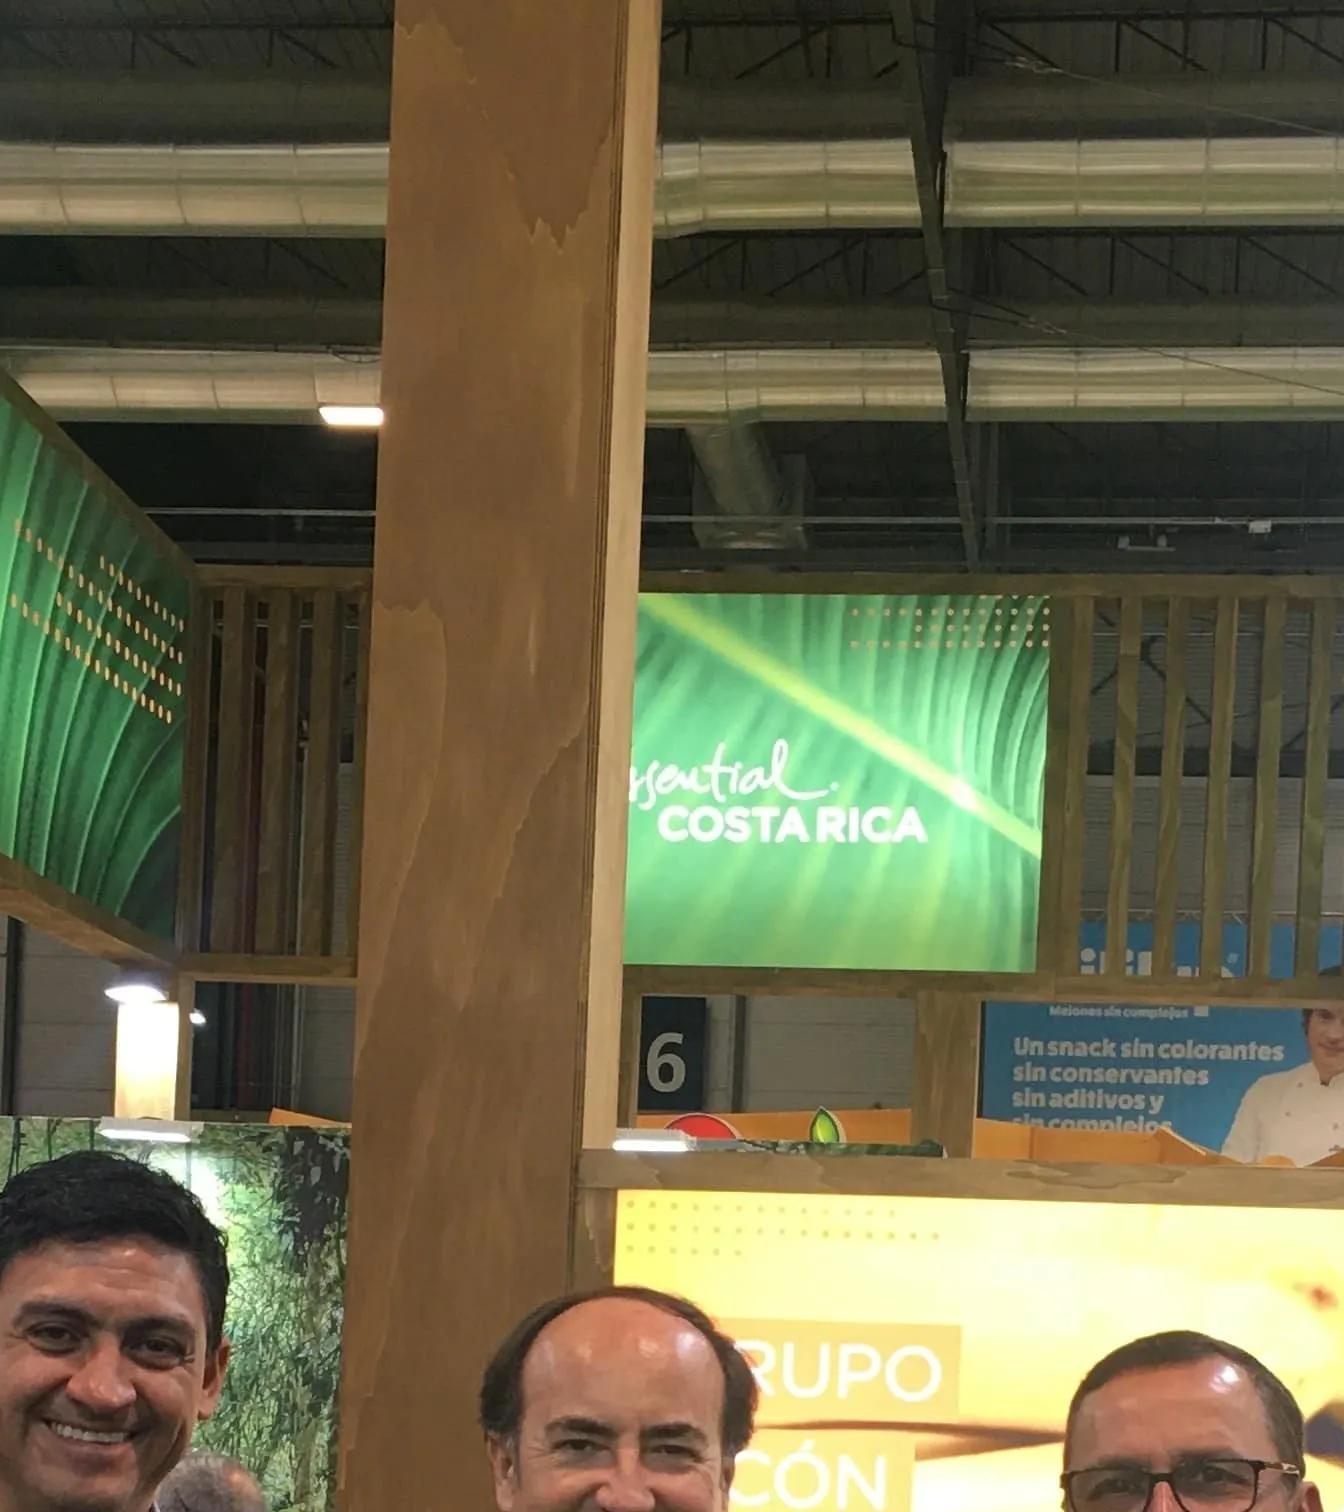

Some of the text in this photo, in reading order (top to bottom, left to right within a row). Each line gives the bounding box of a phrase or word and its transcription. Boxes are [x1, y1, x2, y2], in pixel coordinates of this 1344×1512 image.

[658, 804, 928, 843] COSTA RICA
[646, 1032, 686, 1093] 6
[1013, 1036, 1285, 1061] Un snack sin colorantes
[1012, 1061, 1209, 1086] sin conservantes
[1012, 1087, 1165, 1115] sin aditivos y
